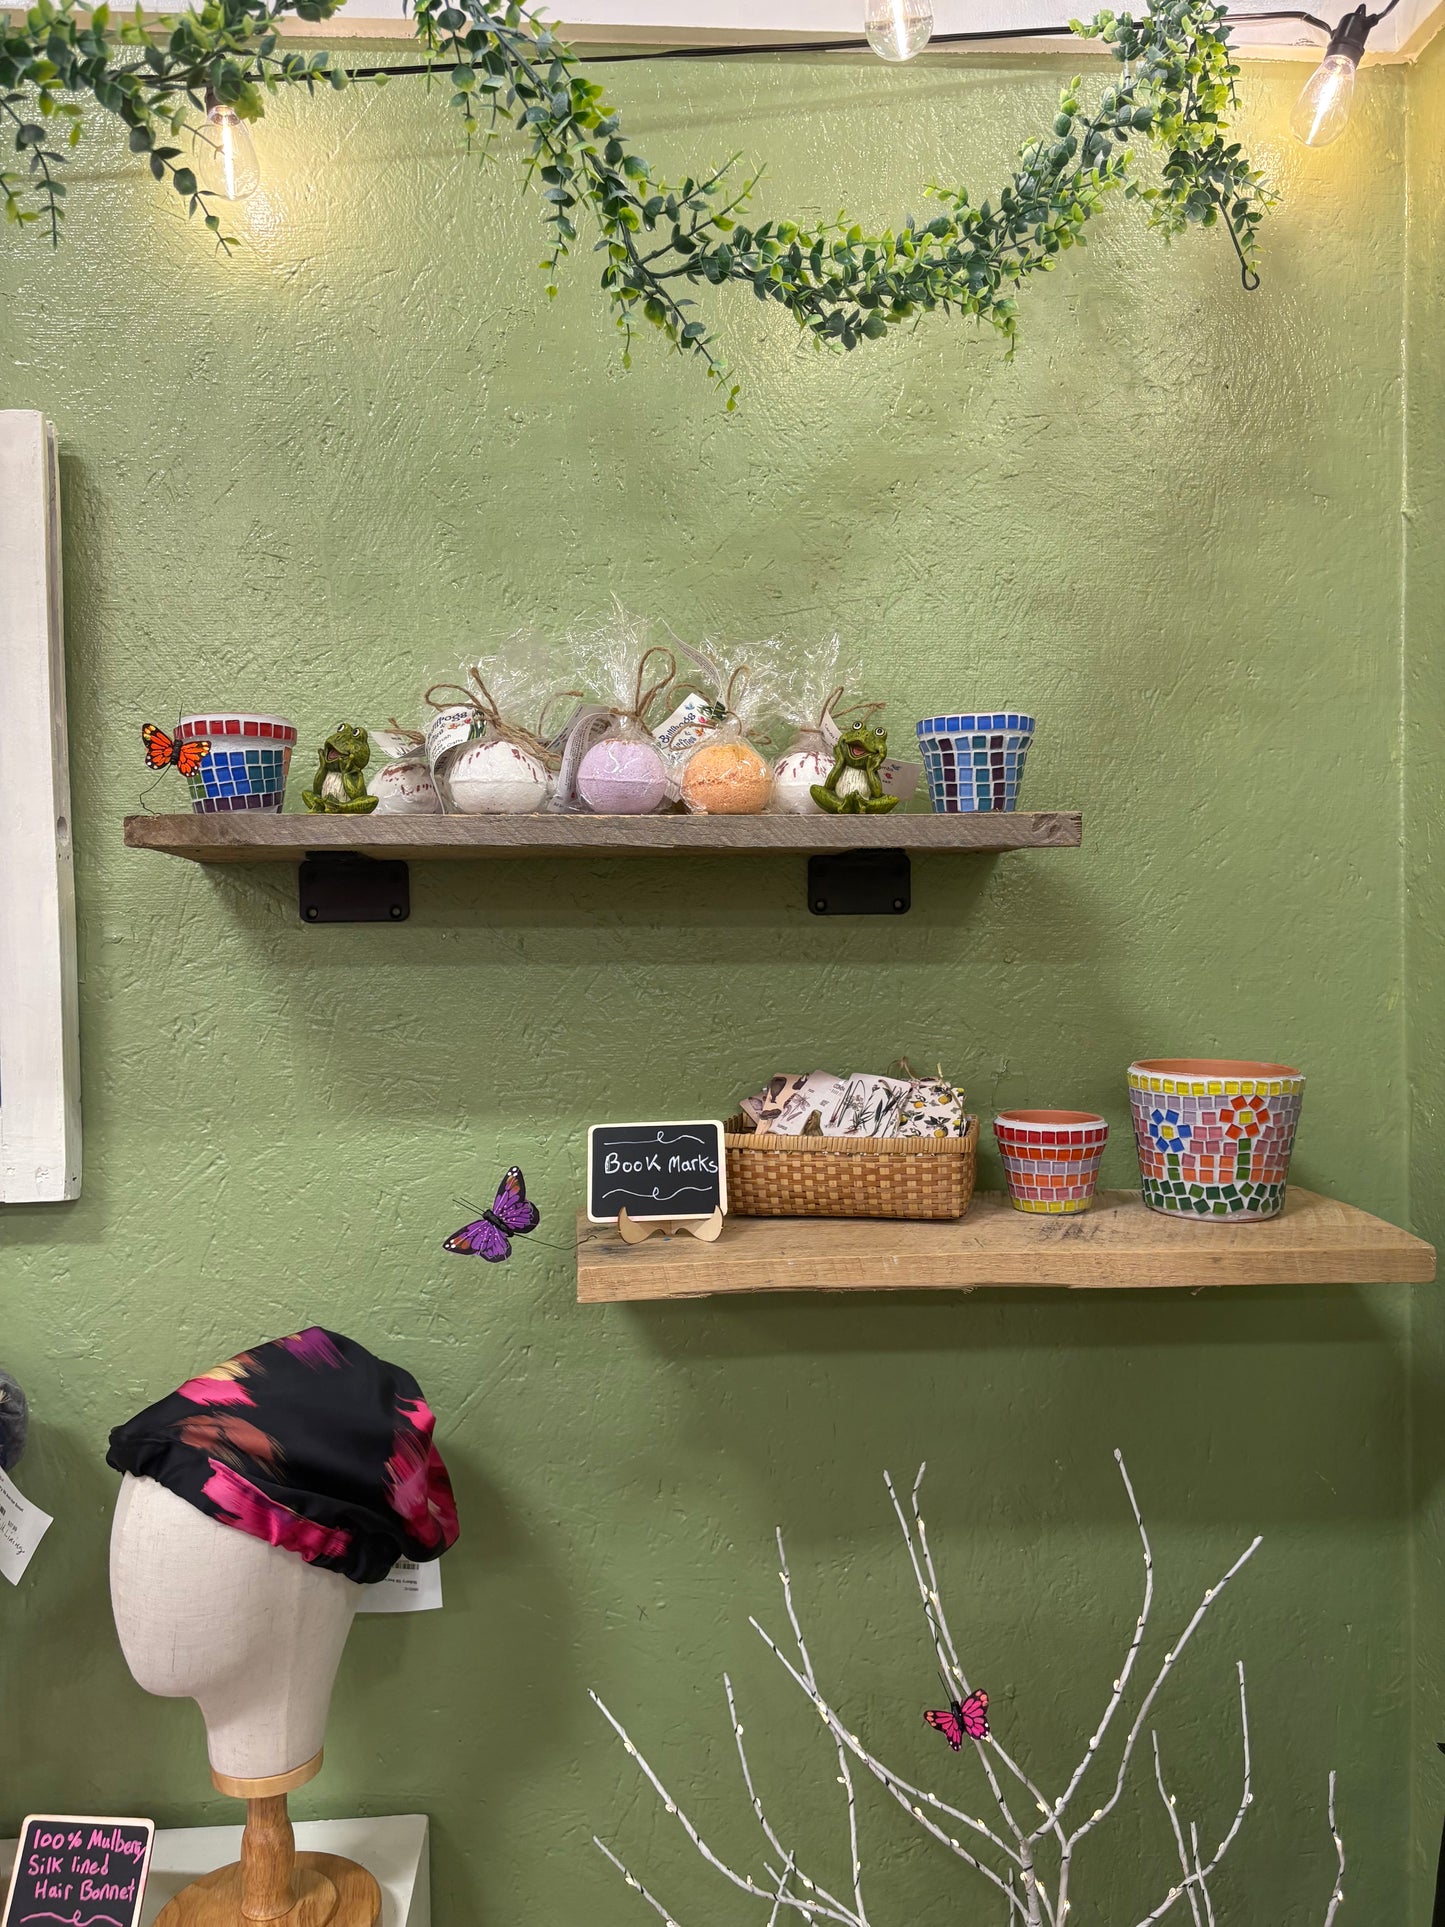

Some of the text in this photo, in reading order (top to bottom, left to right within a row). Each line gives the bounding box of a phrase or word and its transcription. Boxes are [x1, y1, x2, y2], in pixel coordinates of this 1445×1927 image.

[668, 1154, 719, 1174] Marks
[33, 1828, 83, 1850] 100%
[71, 1853, 110, 1875] lined
[34, 1878, 136, 1902] Hair Bonnet
